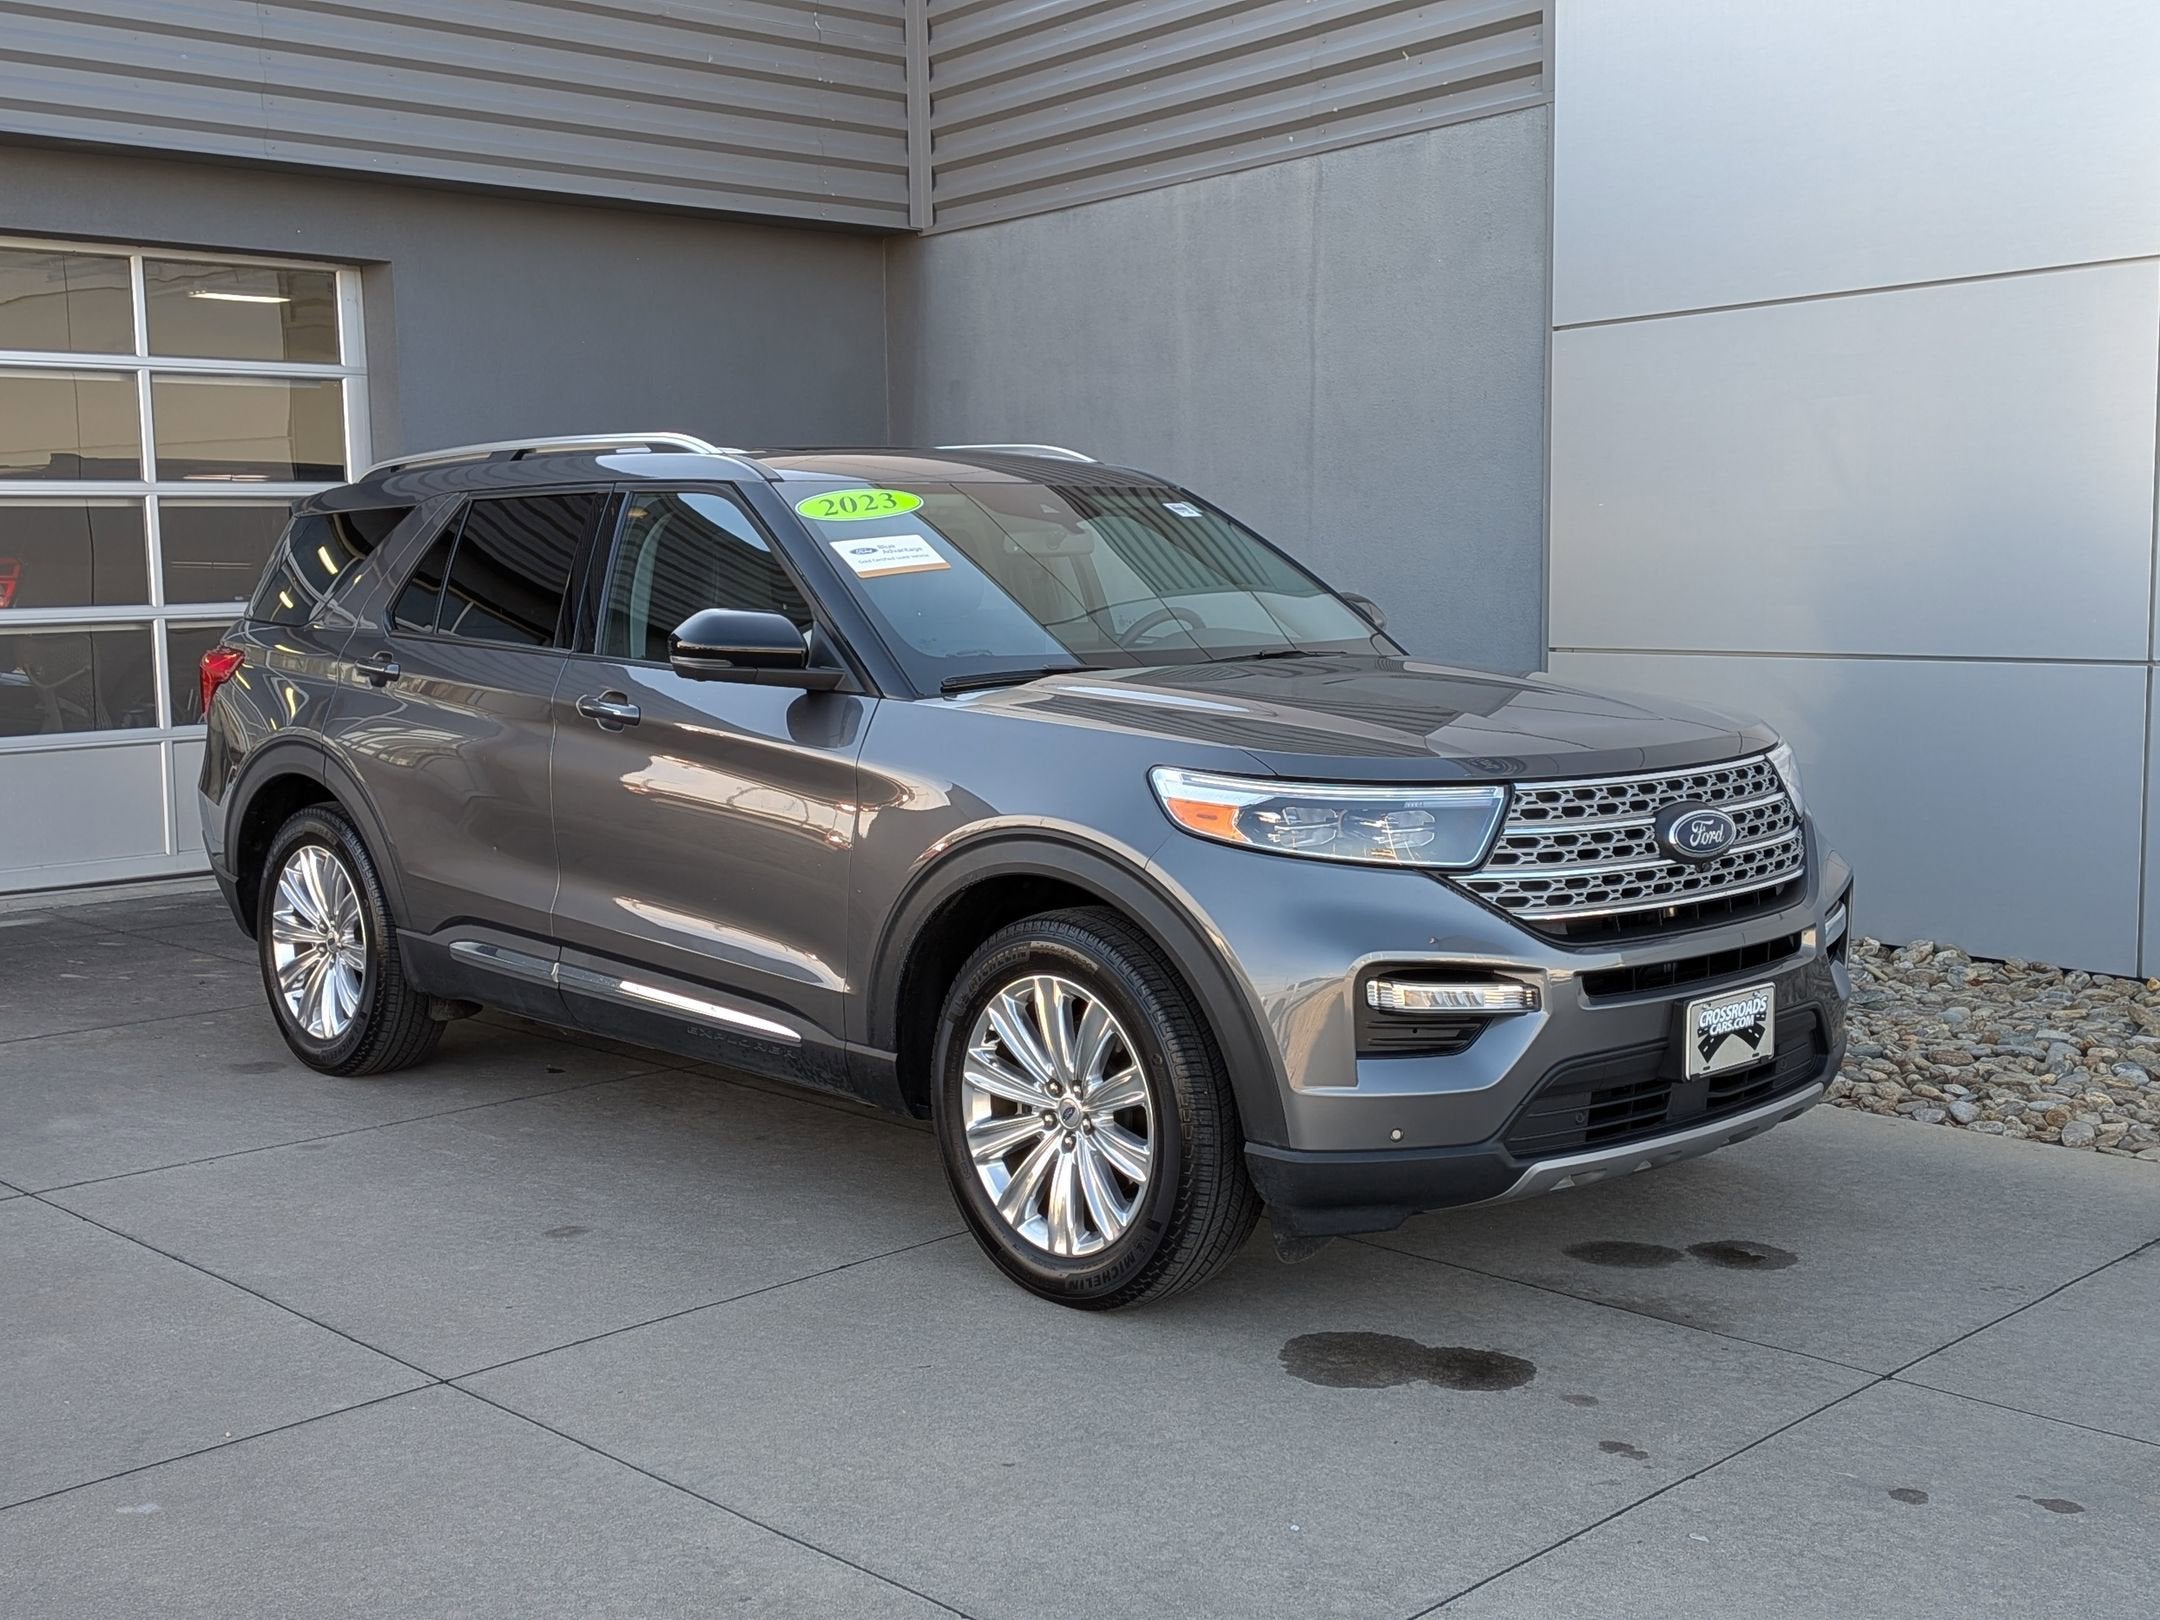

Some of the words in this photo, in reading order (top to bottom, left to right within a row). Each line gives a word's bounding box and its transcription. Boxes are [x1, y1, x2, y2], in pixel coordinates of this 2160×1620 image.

[818, 492, 898, 517] 2023
[1689, 819, 1725, 847] Ford
[1699, 995, 1768, 1027] CROSSROADS
[1709, 1014, 1755, 1035] CARS.COM
[1069, 1250, 1137, 1291] MICHELIN
